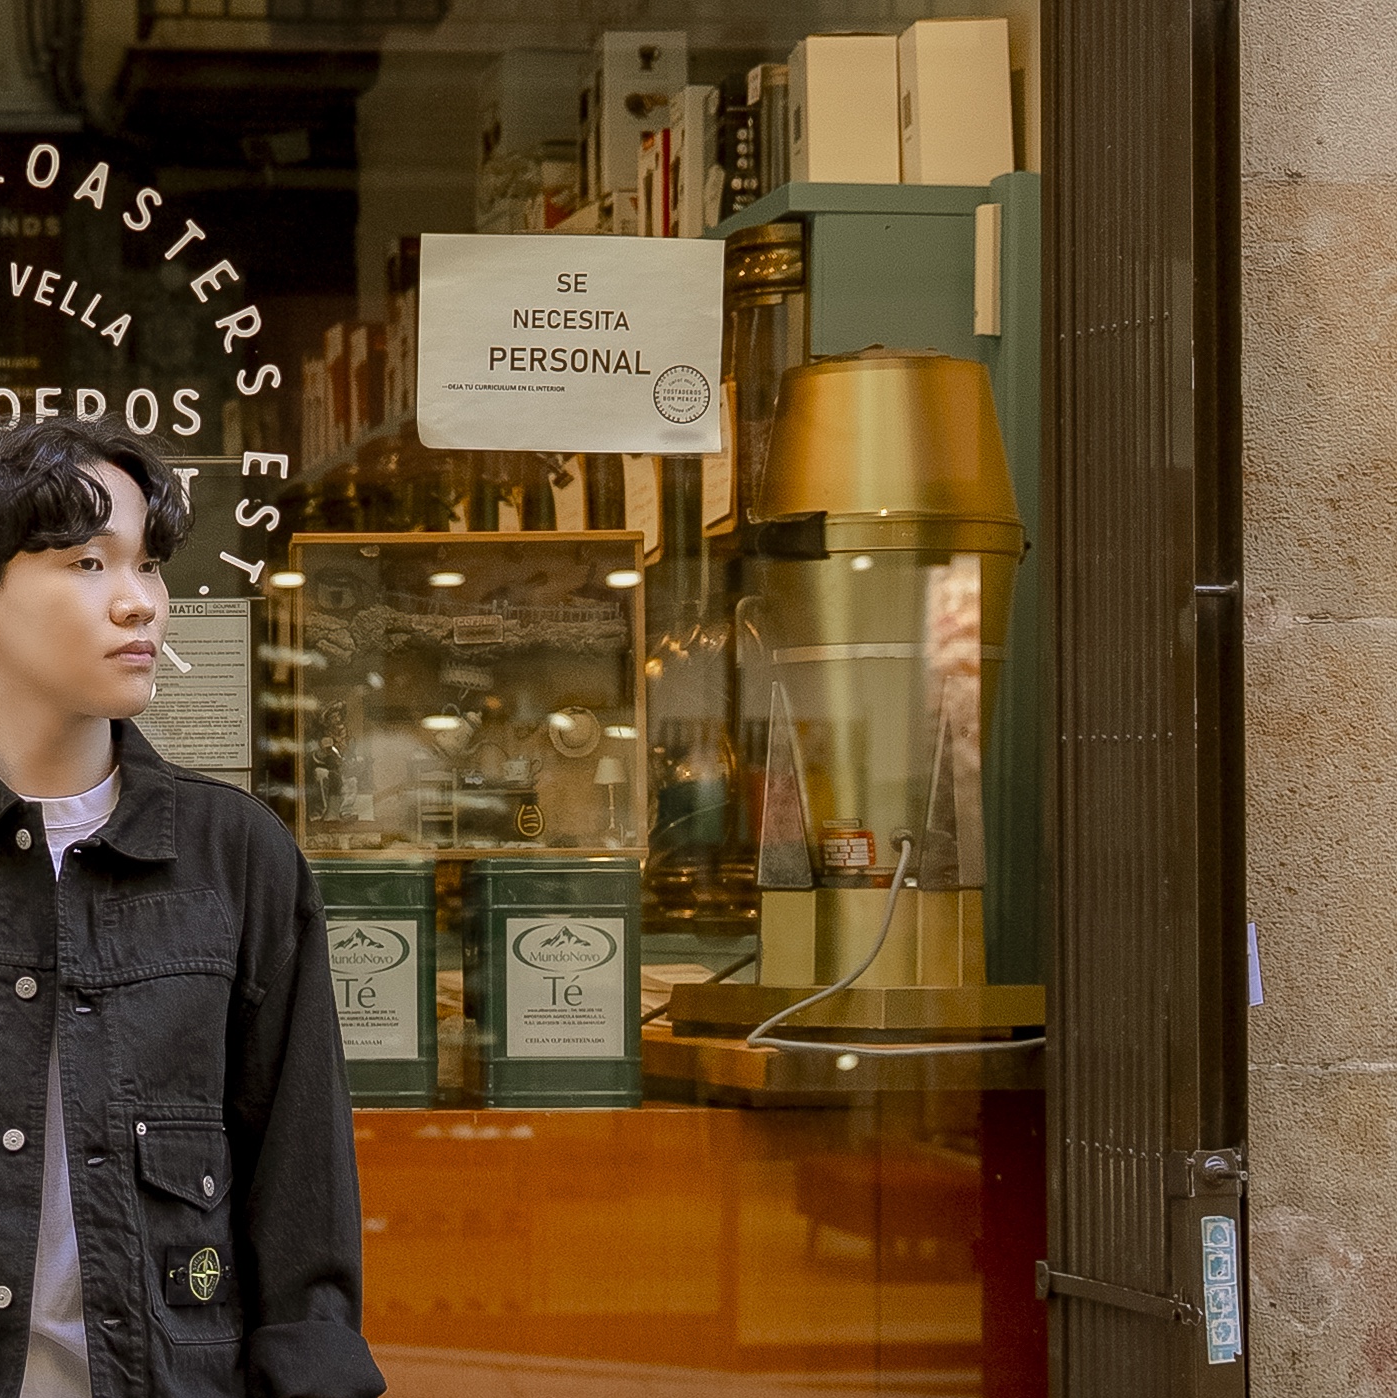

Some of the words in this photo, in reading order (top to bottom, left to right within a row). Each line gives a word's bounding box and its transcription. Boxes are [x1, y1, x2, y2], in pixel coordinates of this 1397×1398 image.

[556, 273, 588, 293] SE
[10, 262, 132, 347] VELLA
[512, 308, 630, 331] NECESITA
[488, 346, 651, 375] PERSONAL
[474, 383, 517, 391] CURRICULUM
[529, 950, 601, 963] MundoNovo
[336, 976, 377, 1009] Té
[543, 975, 583, 1007] Té
